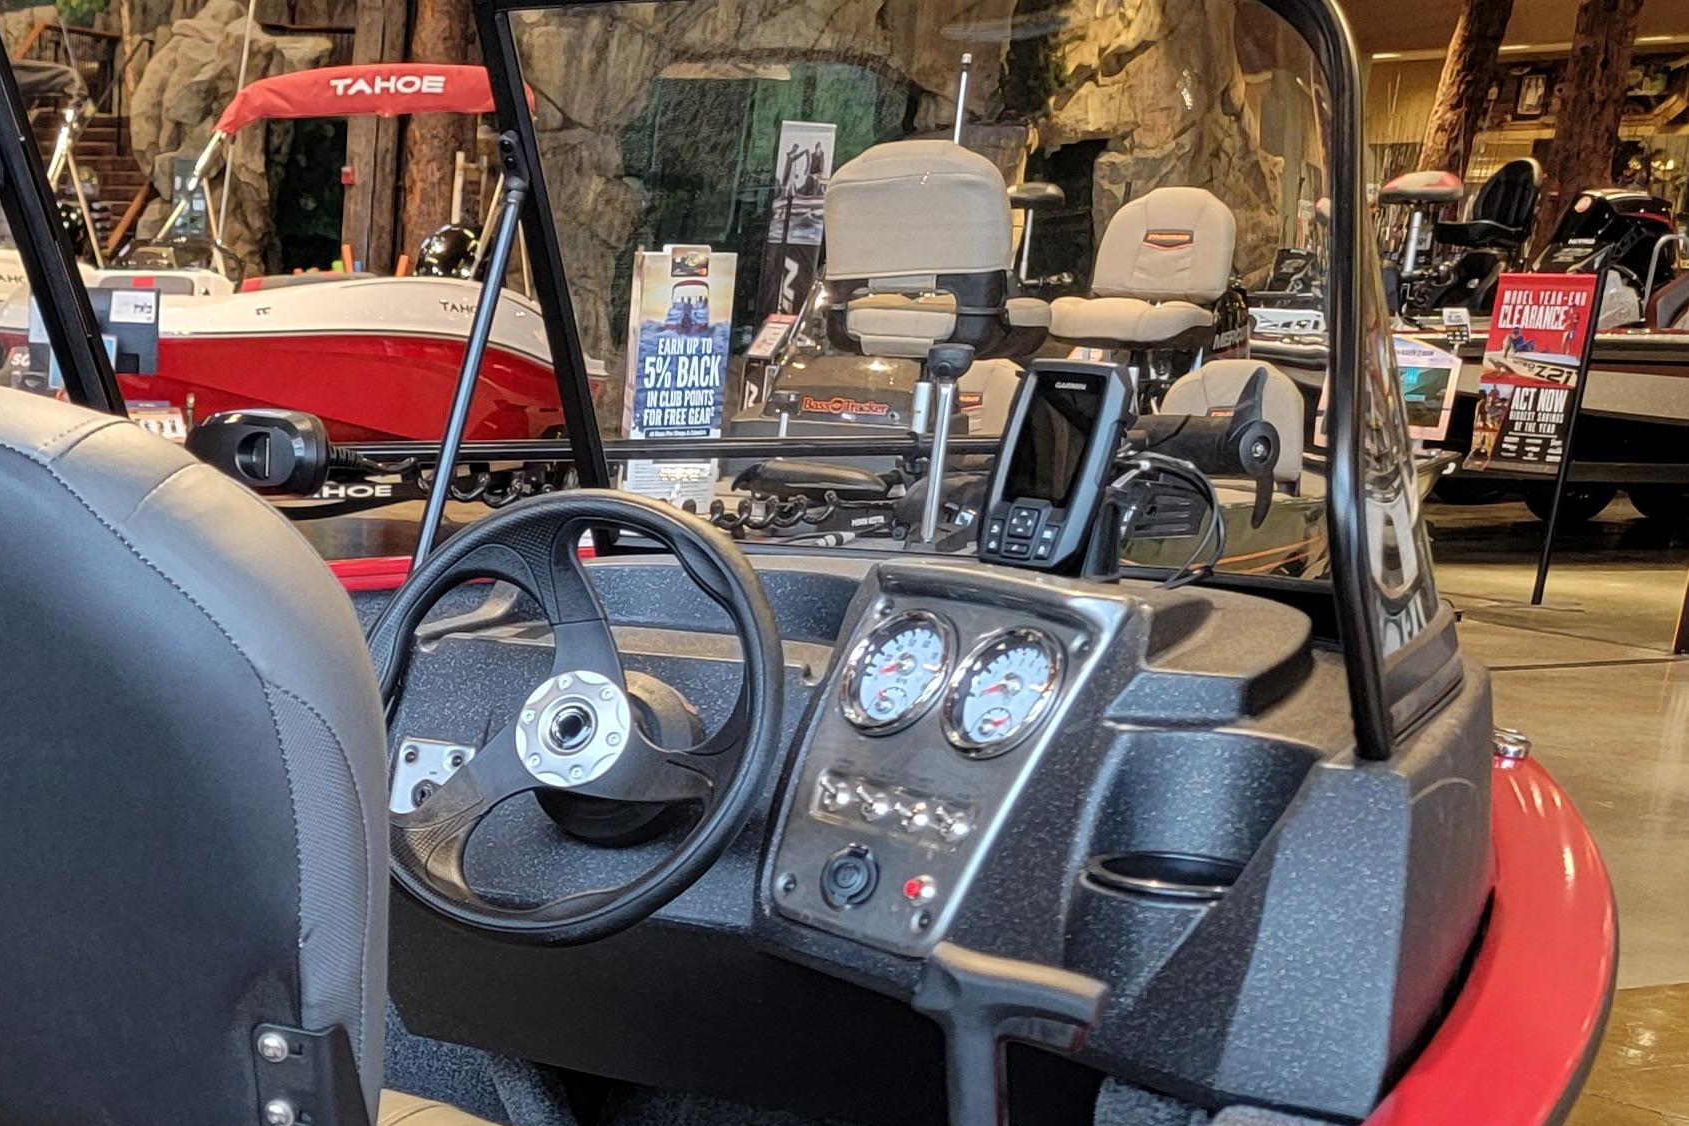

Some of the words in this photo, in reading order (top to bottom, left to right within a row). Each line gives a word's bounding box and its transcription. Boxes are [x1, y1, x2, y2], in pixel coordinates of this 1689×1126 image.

[329, 75, 446, 96] TAHOE
[1503, 290, 1533, 305] MODEL
[1498, 304, 1569, 330] CLEARANCE
[657, 338, 684, 355] EARN
[686, 338, 700, 354] UP
[701, 337, 713, 354] TO
[644, 356, 672, 388] 5%
[676, 355, 722, 388] BACK
[646, 390, 658, 408] IN
[659, 390, 682, 407] CLUB
[683, 389, 715, 407] POINTS
[1511, 387, 1537, 411] ACT
[1537, 388, 1569, 413] NOW
[643, 408, 662, 426] FOR
[663, 408, 688, 426] FREE
[313, 485, 393, 498] HOE
